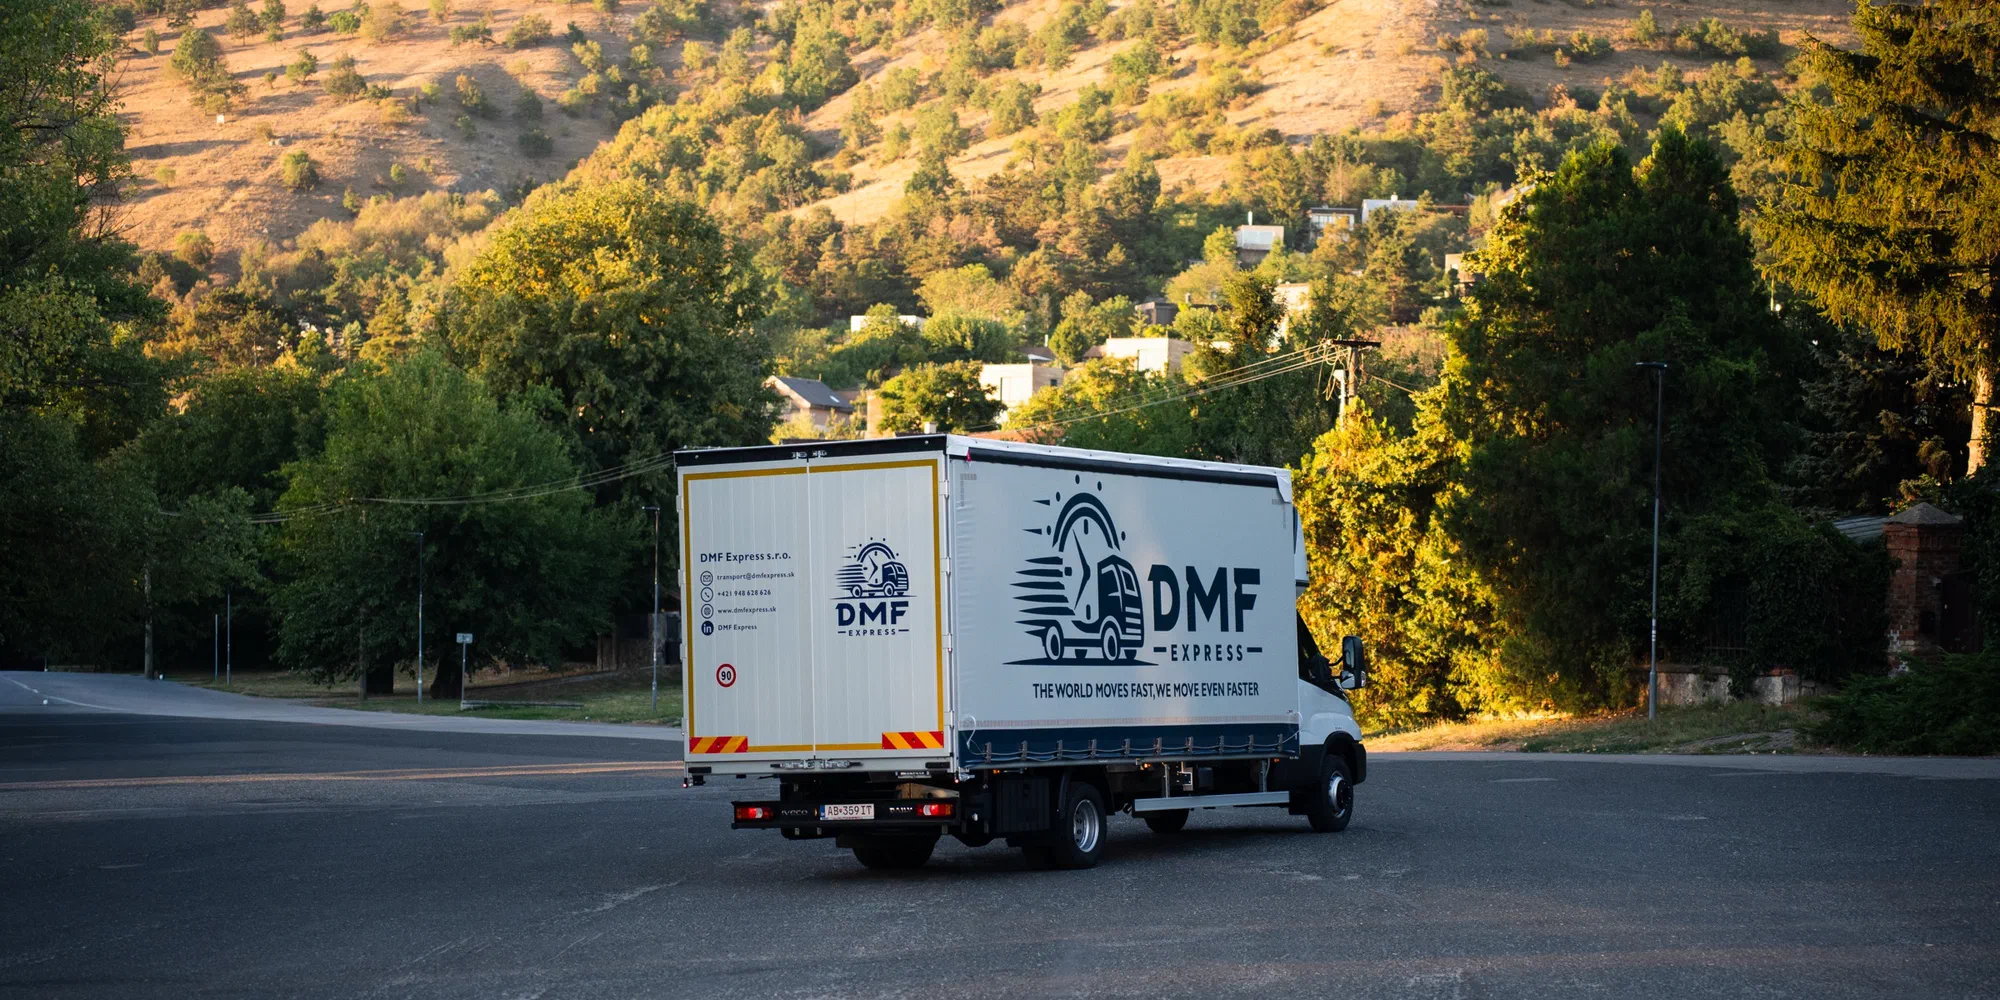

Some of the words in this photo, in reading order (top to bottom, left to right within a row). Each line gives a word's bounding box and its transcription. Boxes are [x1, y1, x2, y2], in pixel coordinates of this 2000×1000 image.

[700, 552, 724, 563] DMF
[726, 552, 765, 564] Express
[766, 552, 791, 560] s.r.o.
[717, 571, 795, 581] transport@dmfexpress.sk
[1147, 564, 1261, 633] DMF
[717, 606, 777, 614] www.dmfexpress.sk
[835, 600, 909, 626] DMF
[733, 624, 758, 632] Express
[848, 628, 896, 637] EXPRESS
[1170, 644, 1244, 662] EXPRESS
[721, 670, 732, 681] 90
[1032, 683, 1054, 699] THE
[1055, 683, 1093, 698] WORLD
[1095, 683, 1129, 698] MOVES
[1173, 683, 1200, 698] MOVE
[1201, 682, 1225, 697] EVEN
[1226, 682, 1260, 697] FASTER
